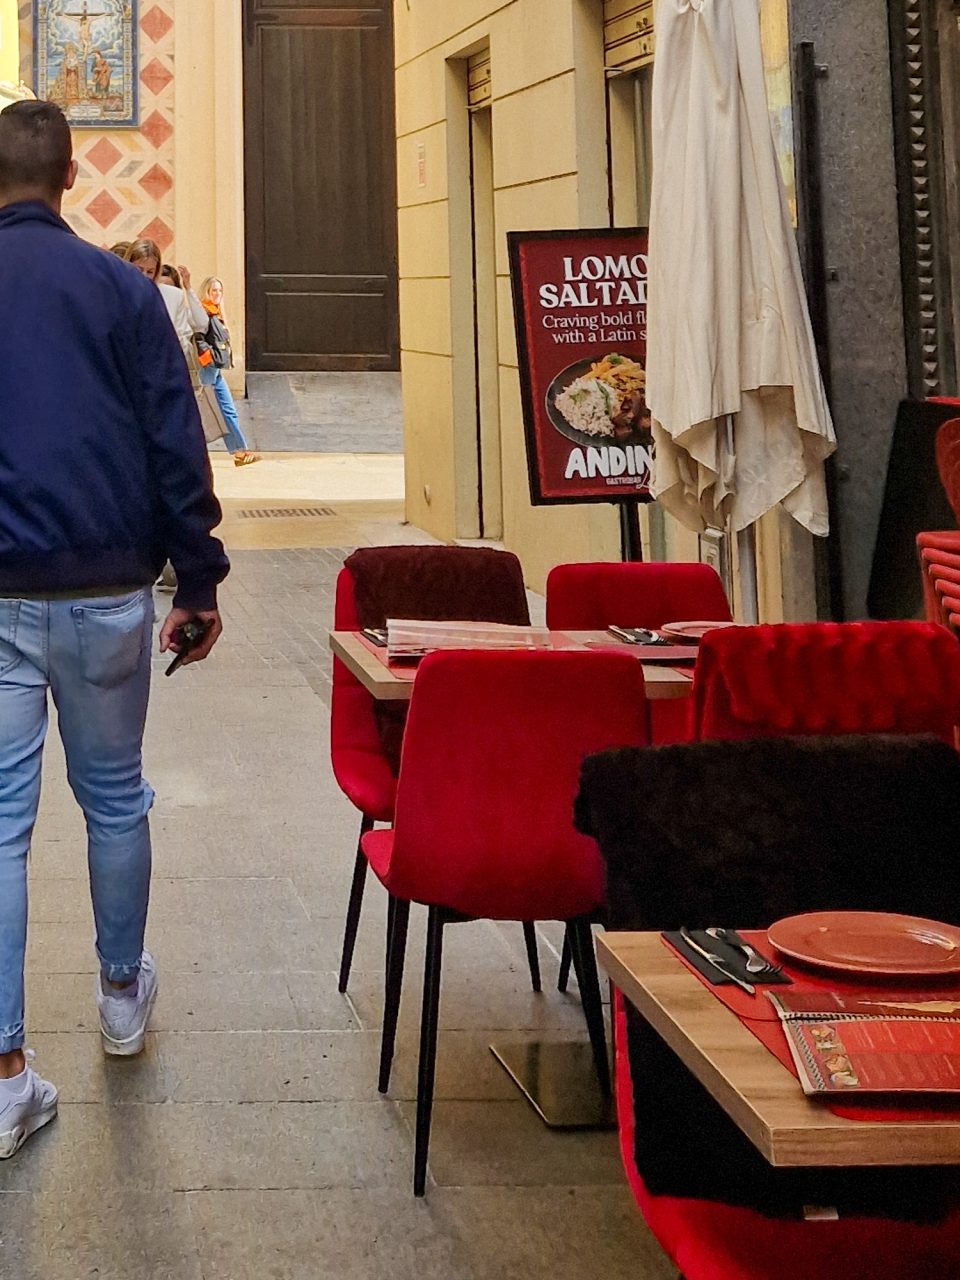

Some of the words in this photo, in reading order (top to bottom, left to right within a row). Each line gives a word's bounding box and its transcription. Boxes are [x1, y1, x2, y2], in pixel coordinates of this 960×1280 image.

[563, 254, 648, 281] LOMO
[542, 313, 599, 330] Craving
[600, 311, 633, 326] bold
[551, 328, 585, 344] with
[588, 331, 597, 342] a
[600, 327, 636, 342] Latin
